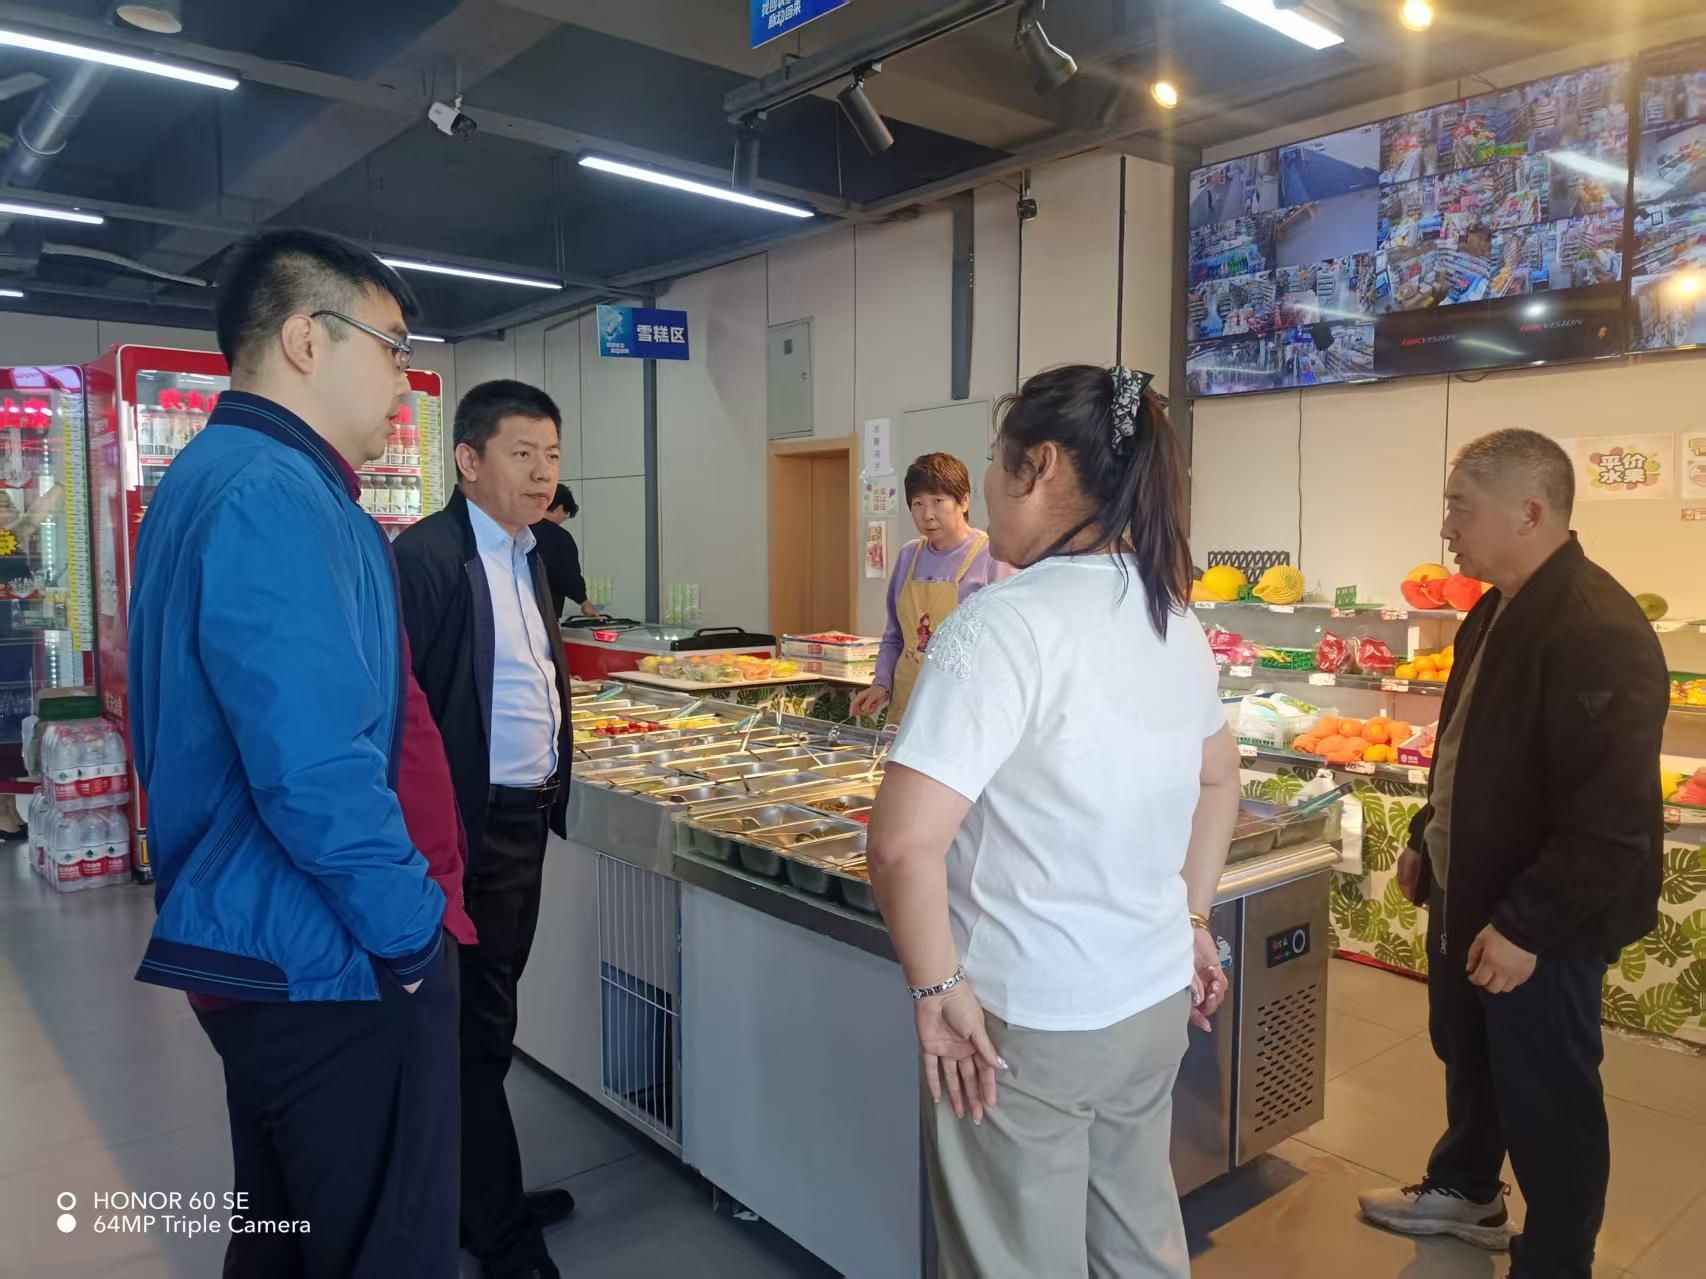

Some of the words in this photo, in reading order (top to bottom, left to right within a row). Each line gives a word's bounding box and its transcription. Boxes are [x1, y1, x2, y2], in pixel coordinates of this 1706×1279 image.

[636, 324, 686, 344] 雪糕区
[1600, 453, 1648, 470] 平价
[1599, 468, 1647, 485] 水果
